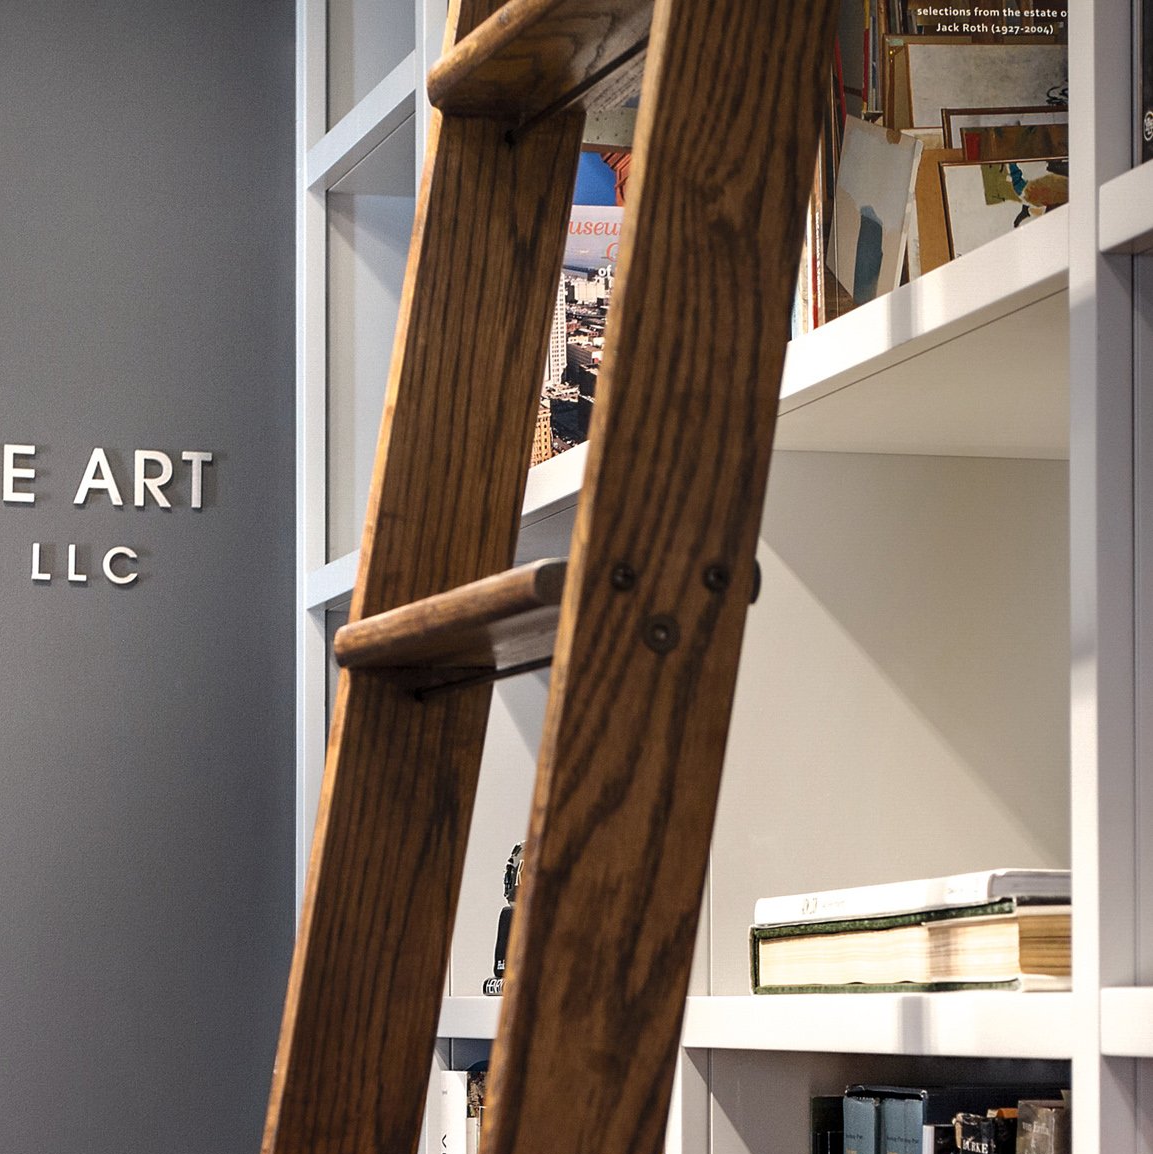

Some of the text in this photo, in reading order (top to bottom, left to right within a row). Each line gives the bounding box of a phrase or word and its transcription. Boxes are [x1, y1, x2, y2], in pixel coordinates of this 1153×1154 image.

[917, 7, 1069, 18] selections from the estate o
[936, 23, 1054, 35] Jack Roth (1927-2004)
[74, 448, 213, 509] ART
[31, 542, 139, 585] LLC
